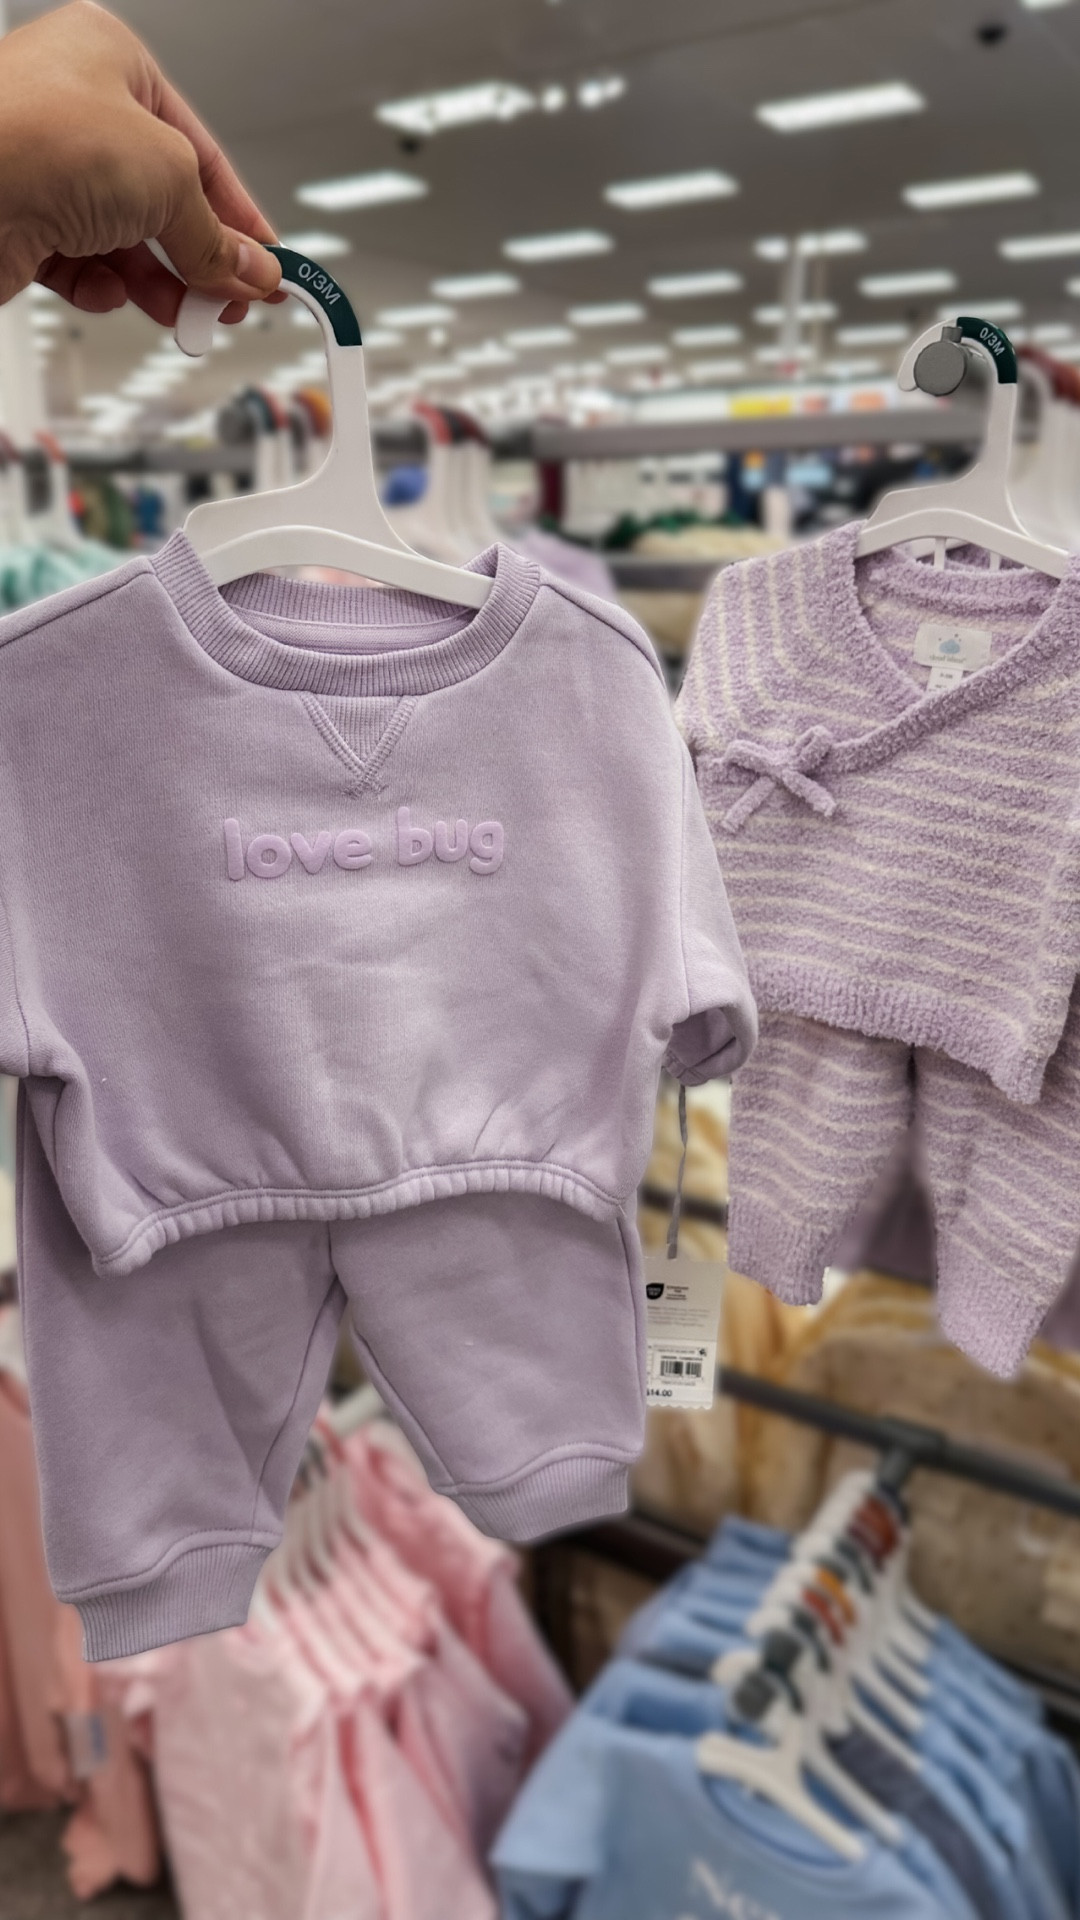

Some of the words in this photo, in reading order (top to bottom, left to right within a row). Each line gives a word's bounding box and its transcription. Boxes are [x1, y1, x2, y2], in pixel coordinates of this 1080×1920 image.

[298, 263, 341, 305] 0/3M
[979, 327, 1005, 356] 0/3M
[224, 818, 373, 881] love
[396, 806, 505, 875] bug
